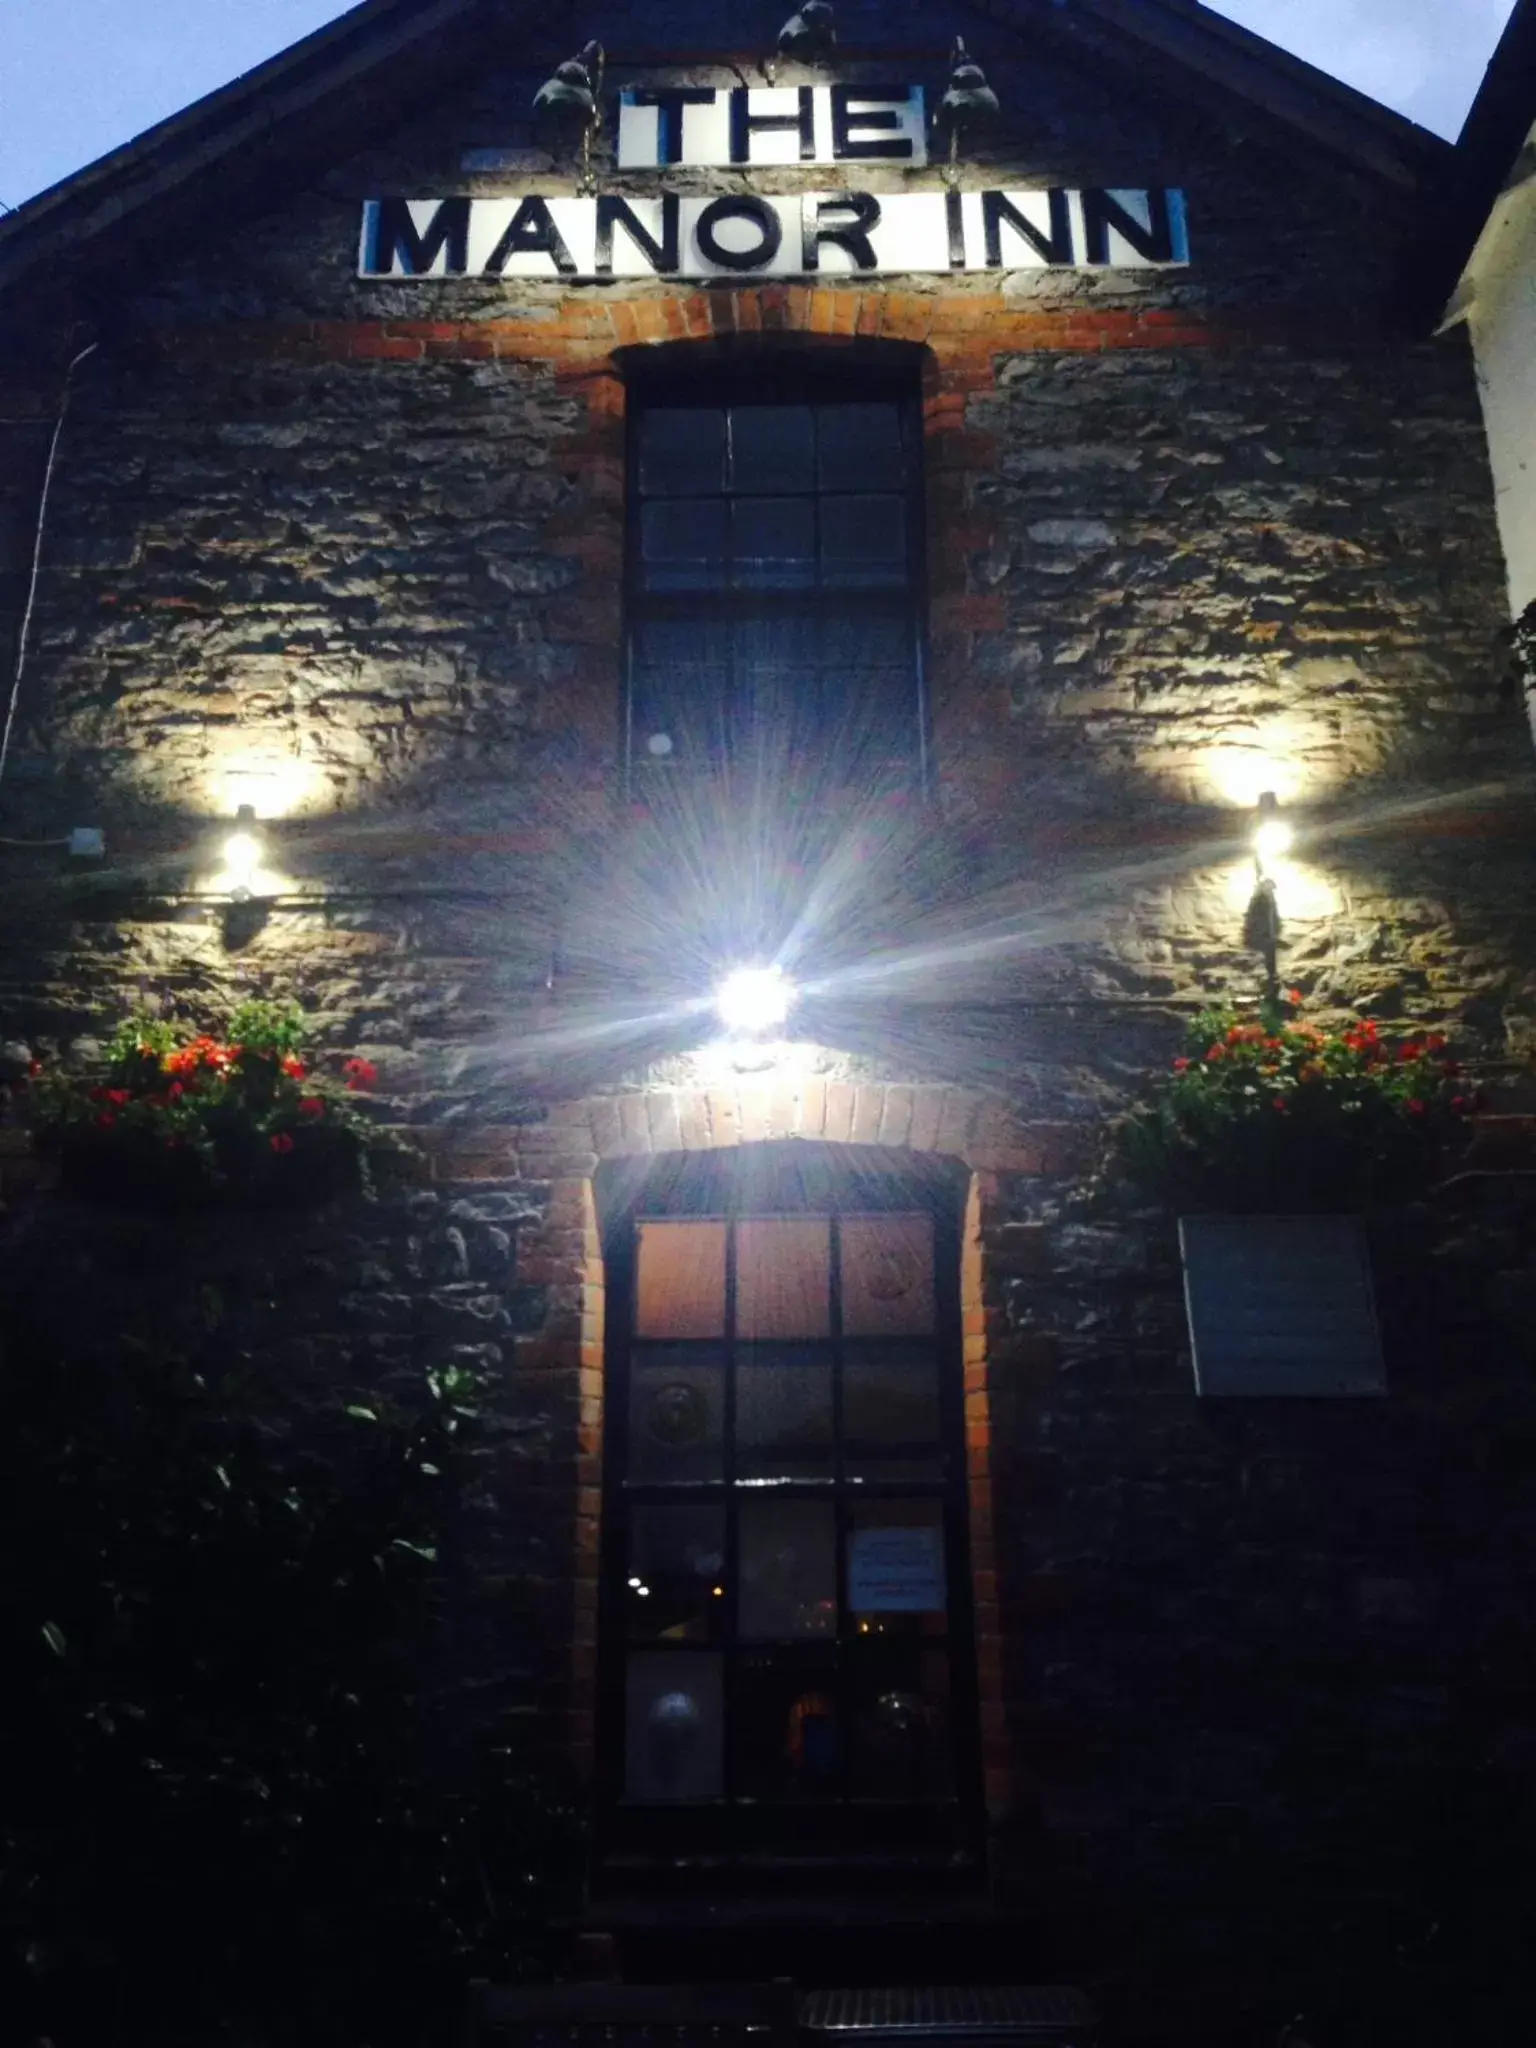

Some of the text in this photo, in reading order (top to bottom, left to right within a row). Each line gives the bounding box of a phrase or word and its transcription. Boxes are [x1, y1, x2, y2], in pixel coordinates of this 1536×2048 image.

[629, 86, 913, 162] THE
[372, 188, 1175, 272] MANOR INN
